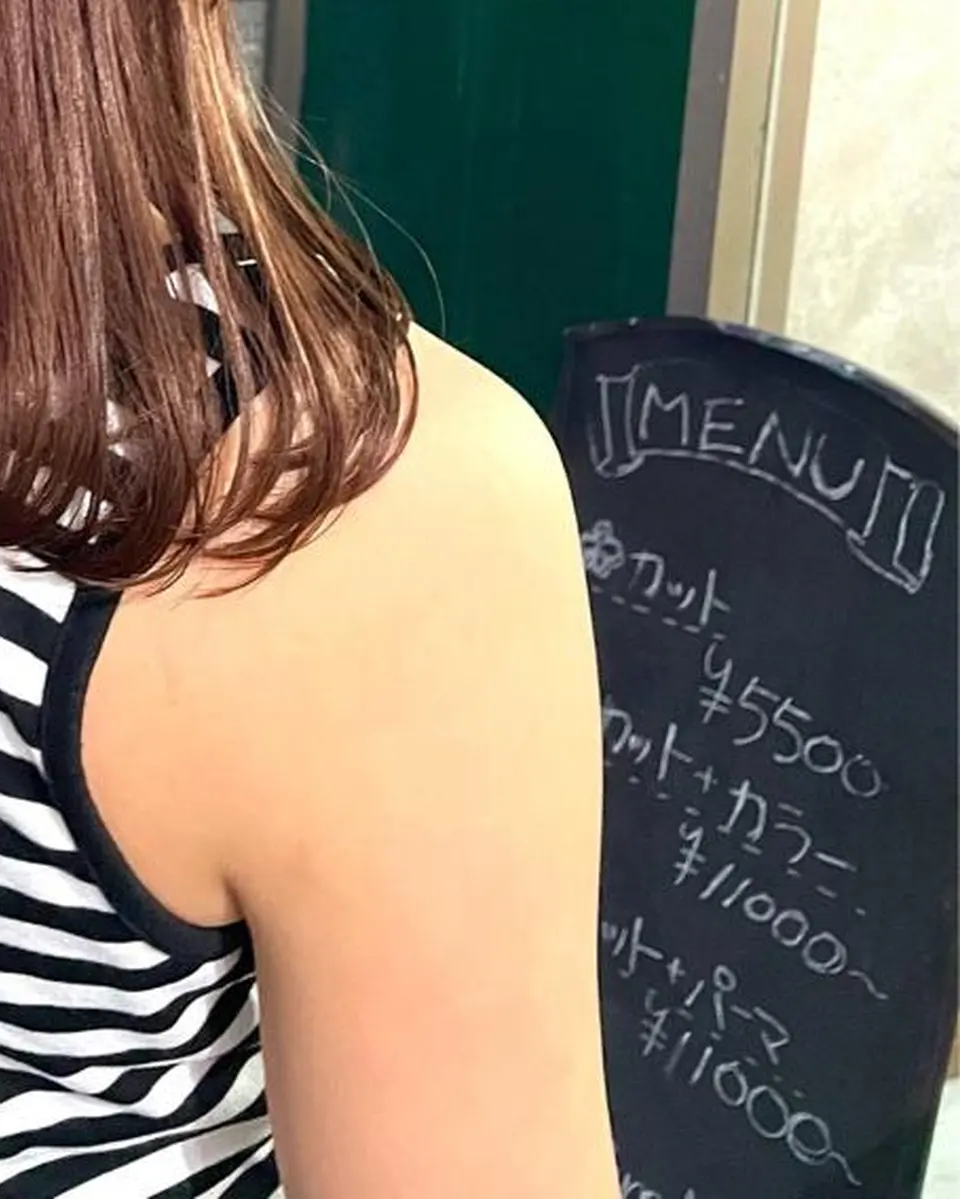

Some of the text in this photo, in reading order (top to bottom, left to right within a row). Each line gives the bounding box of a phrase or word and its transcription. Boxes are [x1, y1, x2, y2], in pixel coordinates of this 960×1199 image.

[640, 382, 866, 501] MENU
[628, 550, 732, 626] カット
[698, 641, 882, 798] ¥5500
